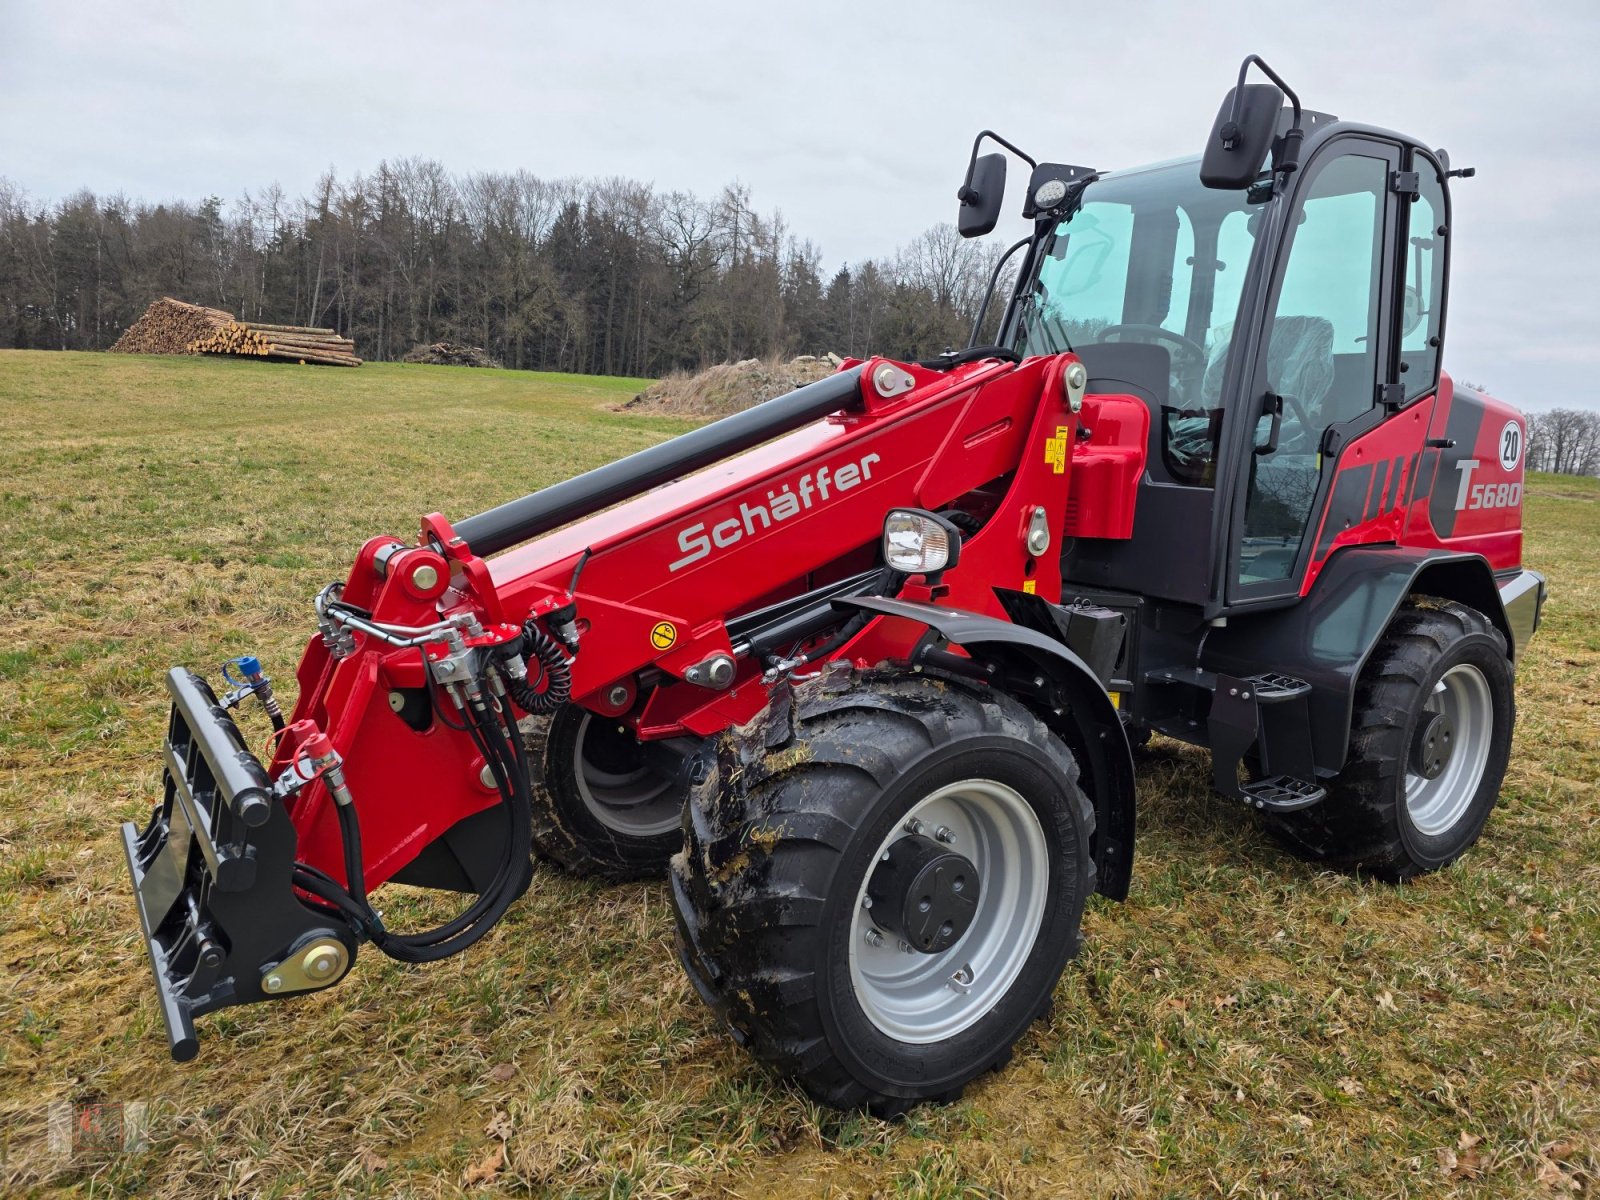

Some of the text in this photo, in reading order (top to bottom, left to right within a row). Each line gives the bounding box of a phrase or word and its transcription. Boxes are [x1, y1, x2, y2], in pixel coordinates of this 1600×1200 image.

[1503, 431, 1518, 462] 20
[669, 452, 880, 573] Schäffer
[1054, 810, 1078, 917] ALLIANCE
